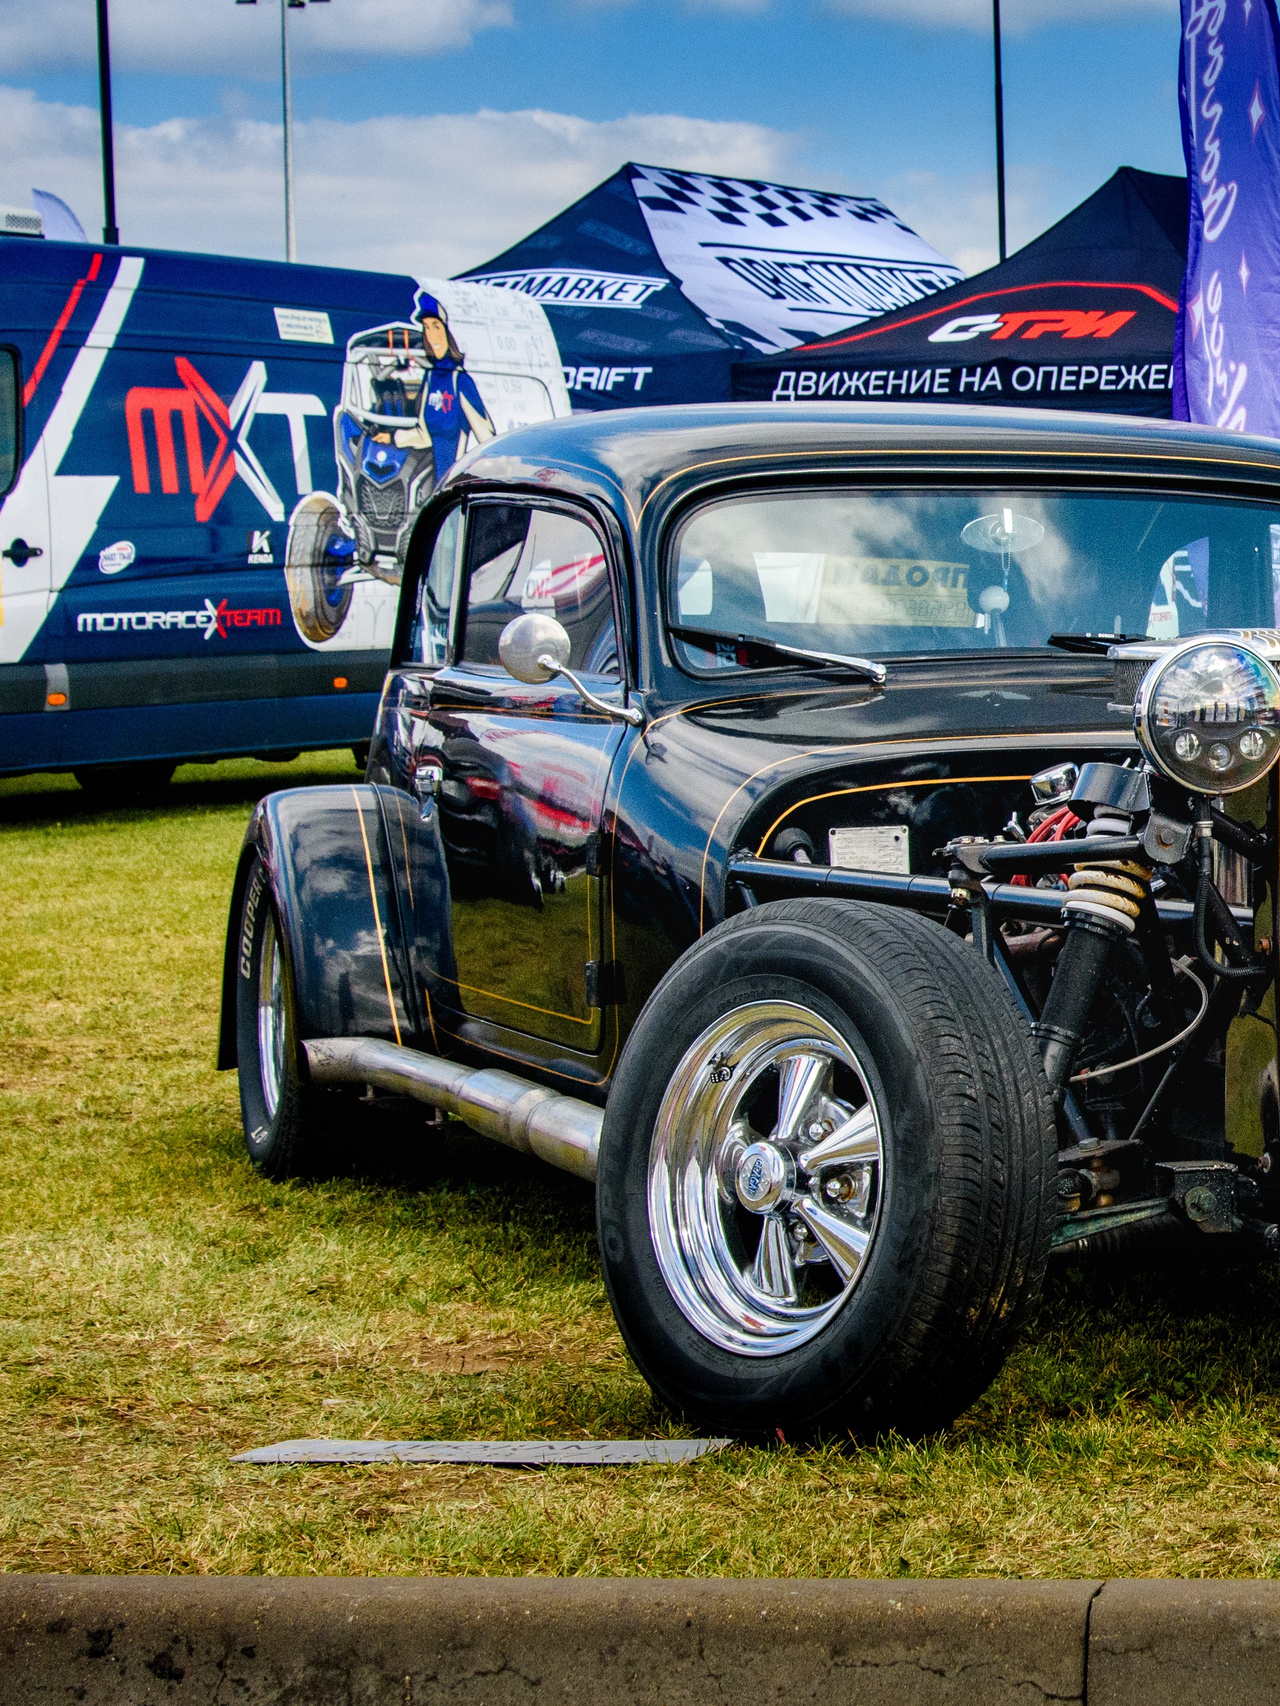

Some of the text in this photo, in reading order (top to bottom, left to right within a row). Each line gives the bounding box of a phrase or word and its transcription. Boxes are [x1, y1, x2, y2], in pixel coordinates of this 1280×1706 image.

[772, 364, 1174, 401] ДВИЖЕНИЕ НА ОПЕРЕЖЕ
[125, 357, 327, 522] MXT
[240, 883, 261, 979] COOPER
